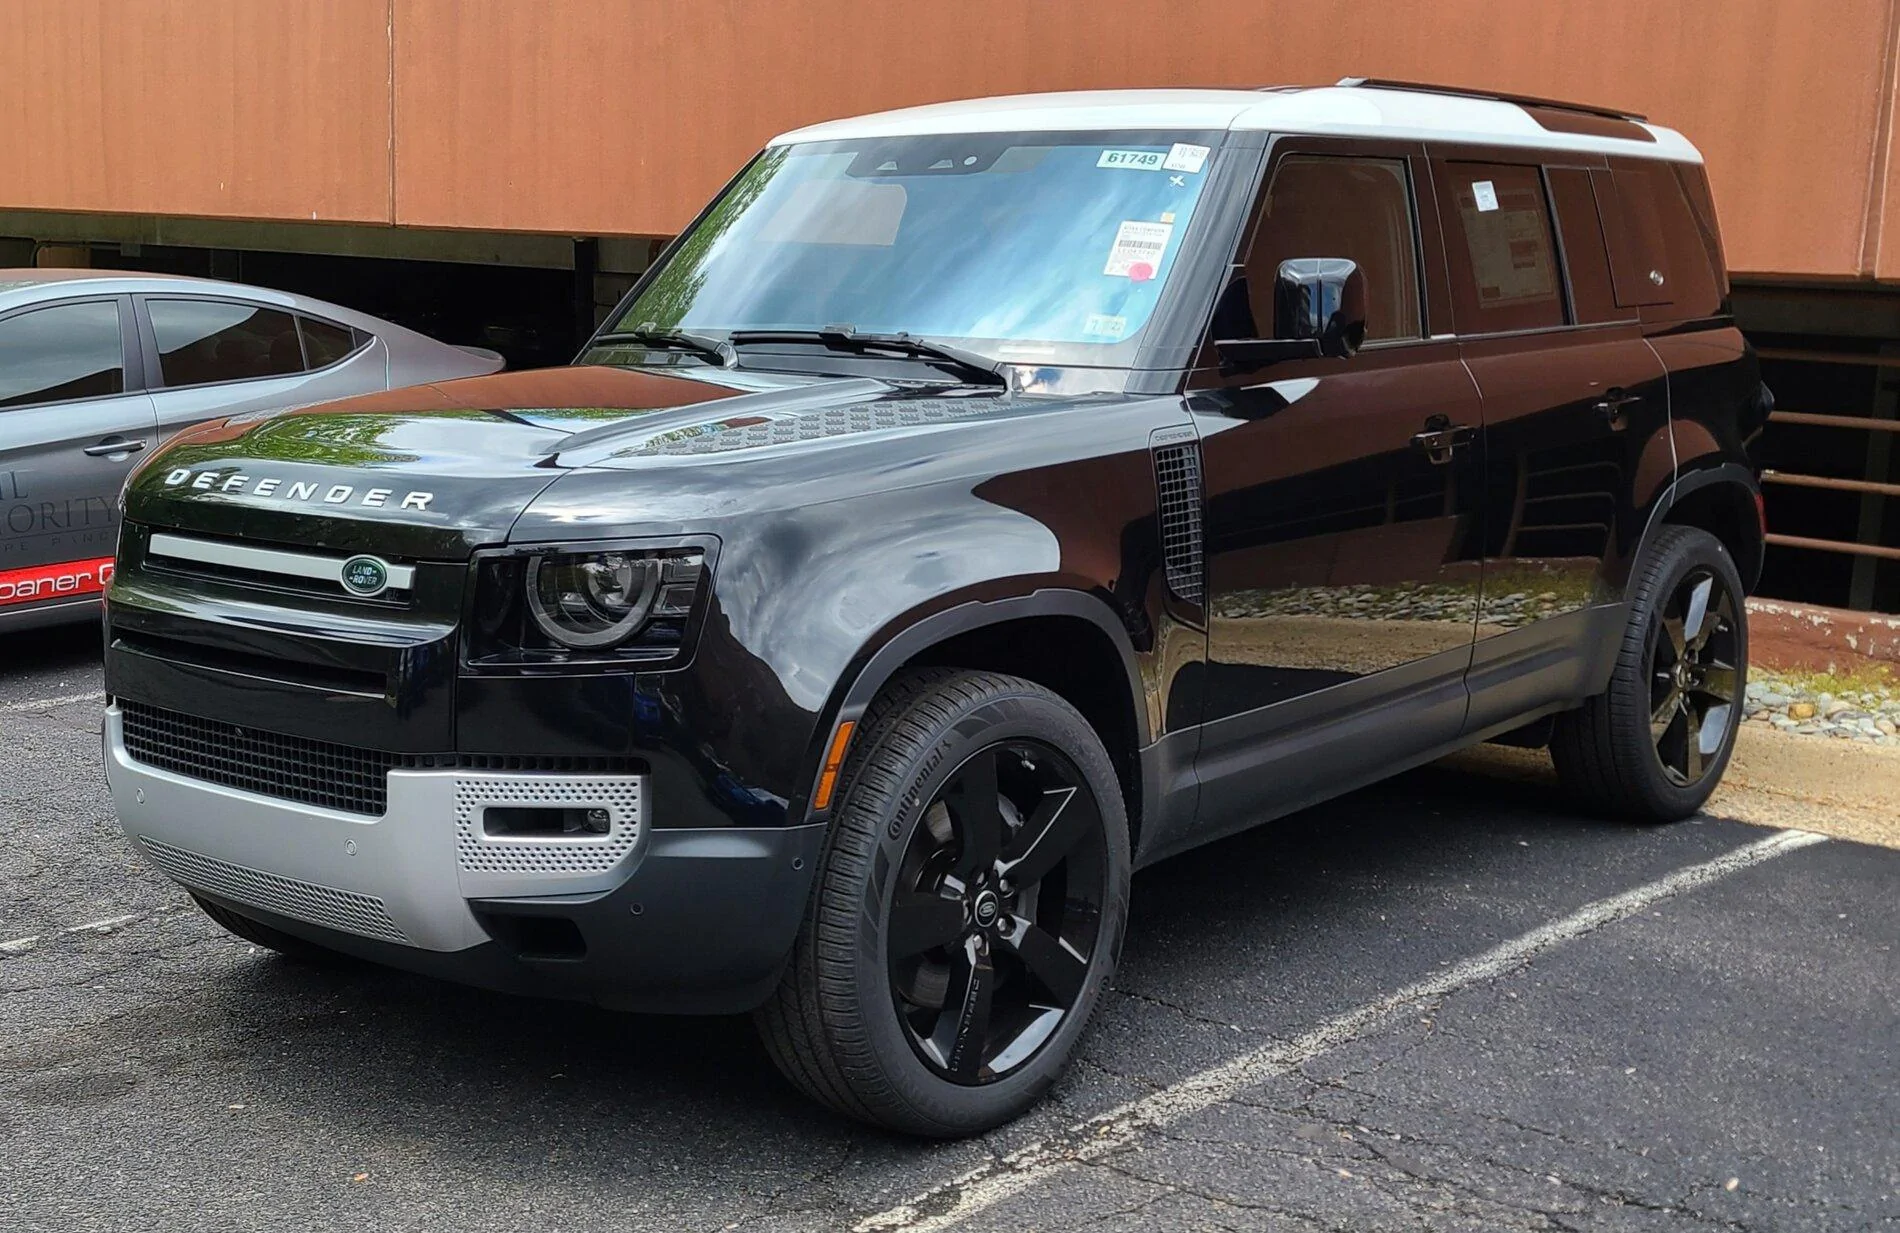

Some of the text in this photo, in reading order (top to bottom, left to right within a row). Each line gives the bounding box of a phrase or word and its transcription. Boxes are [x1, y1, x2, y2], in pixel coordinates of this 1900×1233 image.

[1107, 152, 1158, 166] 61749
[164, 468, 435, 511] DEFENDER
[886, 744, 944, 843] Continental
